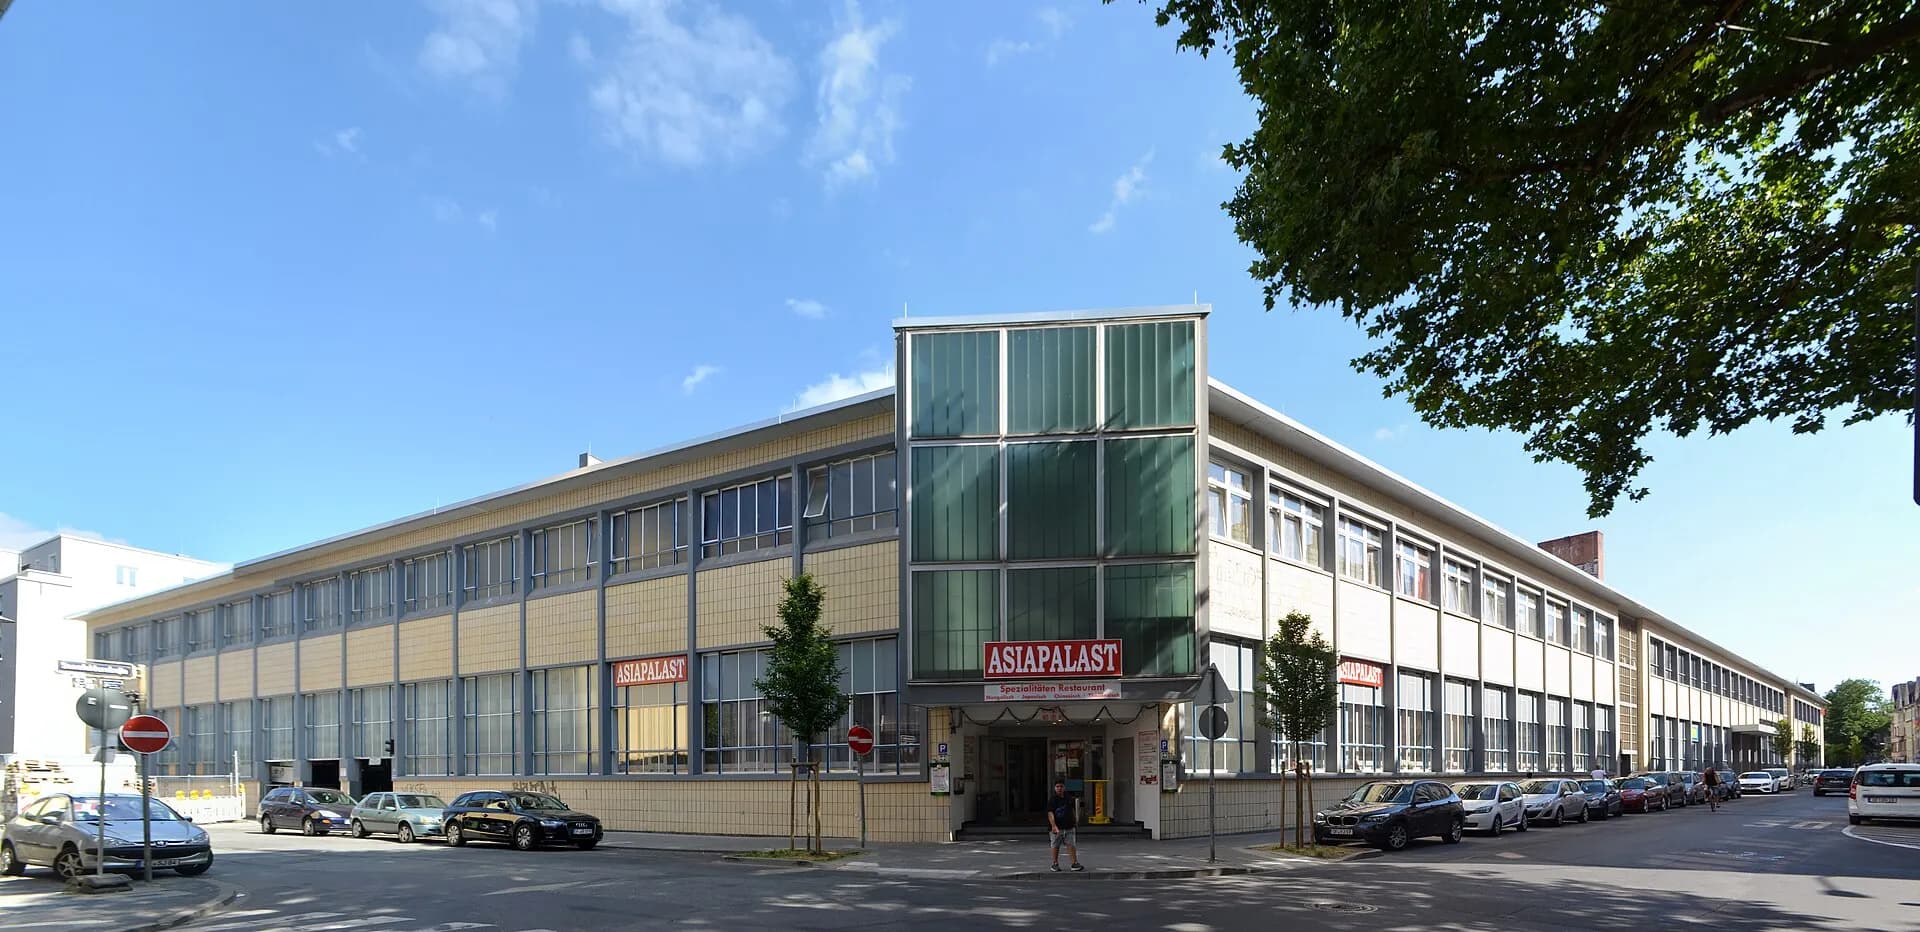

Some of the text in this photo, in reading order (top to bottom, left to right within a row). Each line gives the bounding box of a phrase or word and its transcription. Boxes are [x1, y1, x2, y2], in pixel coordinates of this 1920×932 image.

[988, 643, 1118, 673] ASIAPALAST
[617, 659, 685, 683] ASIAPALAST
[1000, 683, 1105, 694] Spezialitäten Restaurant
